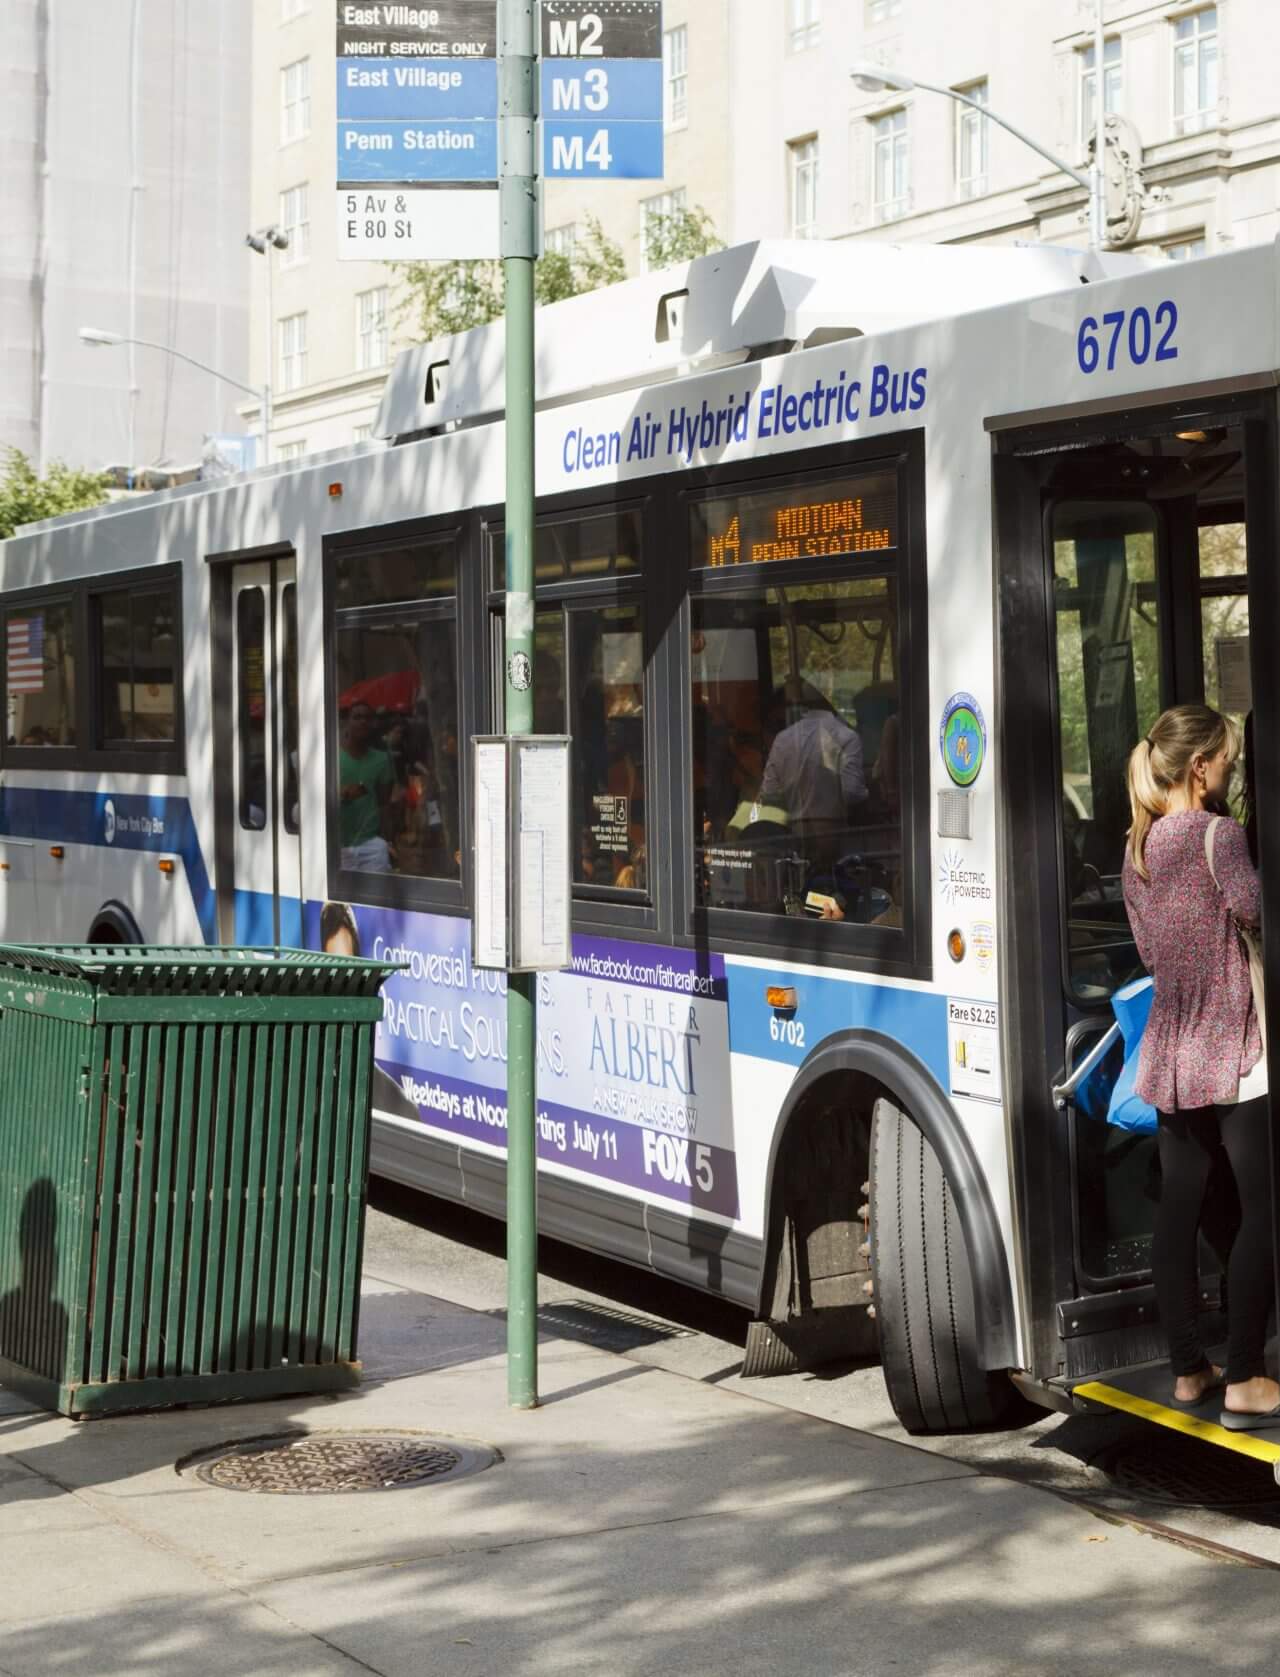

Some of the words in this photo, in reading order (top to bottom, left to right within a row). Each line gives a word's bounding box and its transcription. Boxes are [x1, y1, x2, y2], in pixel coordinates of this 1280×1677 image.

[344, 6, 380, 25] East
[383, 6, 439, 29] Village
[344, 42, 387, 55] NIGHT
[390, 42, 448, 55] SERVICE
[452, 42, 487, 55] ONLY
[550, 14, 603, 56] M2
[347, 68, 391, 87] East
[394, 68, 462, 90] Village
[552, 69, 609, 111] M3
[345, 132, 392, 149] Penn
[404, 131, 475, 149] Station
[552, 129, 613, 170] M4
[347, 196, 357, 213] 5
[365, 196, 386, 213] Av
[394, 196, 407, 213] &
[347, 221, 357, 238] E
[365, 221, 386, 238] 80
[394, 221, 412, 238] St
[1078, 300, 1178, 373] 6702
[563, 429, 621, 473] Clean
[626, 411, 661, 462] Air
[667, 391, 751, 463] Hybrid
[757, 371, 861, 438] Electric
[869, 364, 928, 418] Bus
[711, 516, 740, 568] M4
[777, 499, 863, 538] MIDTOWN
[752, 540, 800, 563] PENN
[805, 529, 889, 556] STATION
[950, 870, 986, 884] ELECTRIC
[954, 885, 991, 899] POWERED
[587, 987, 699, 1031] FATHER
[950, 1004, 969, 1020] Fare
[970, 1007, 996, 1024] $2.25
[769, 1017, 806, 1048] 6702
[590, 1014, 700, 1096] ALBERT
[401, 1075, 460, 1118] Weekdays
[463, 1095, 476, 1120] at
[573, 1120, 600, 1160] July
[602, 1129, 618, 1160] 11
[642, 1129, 693, 1186] FOX
[695, 1144, 714, 1193] 5
